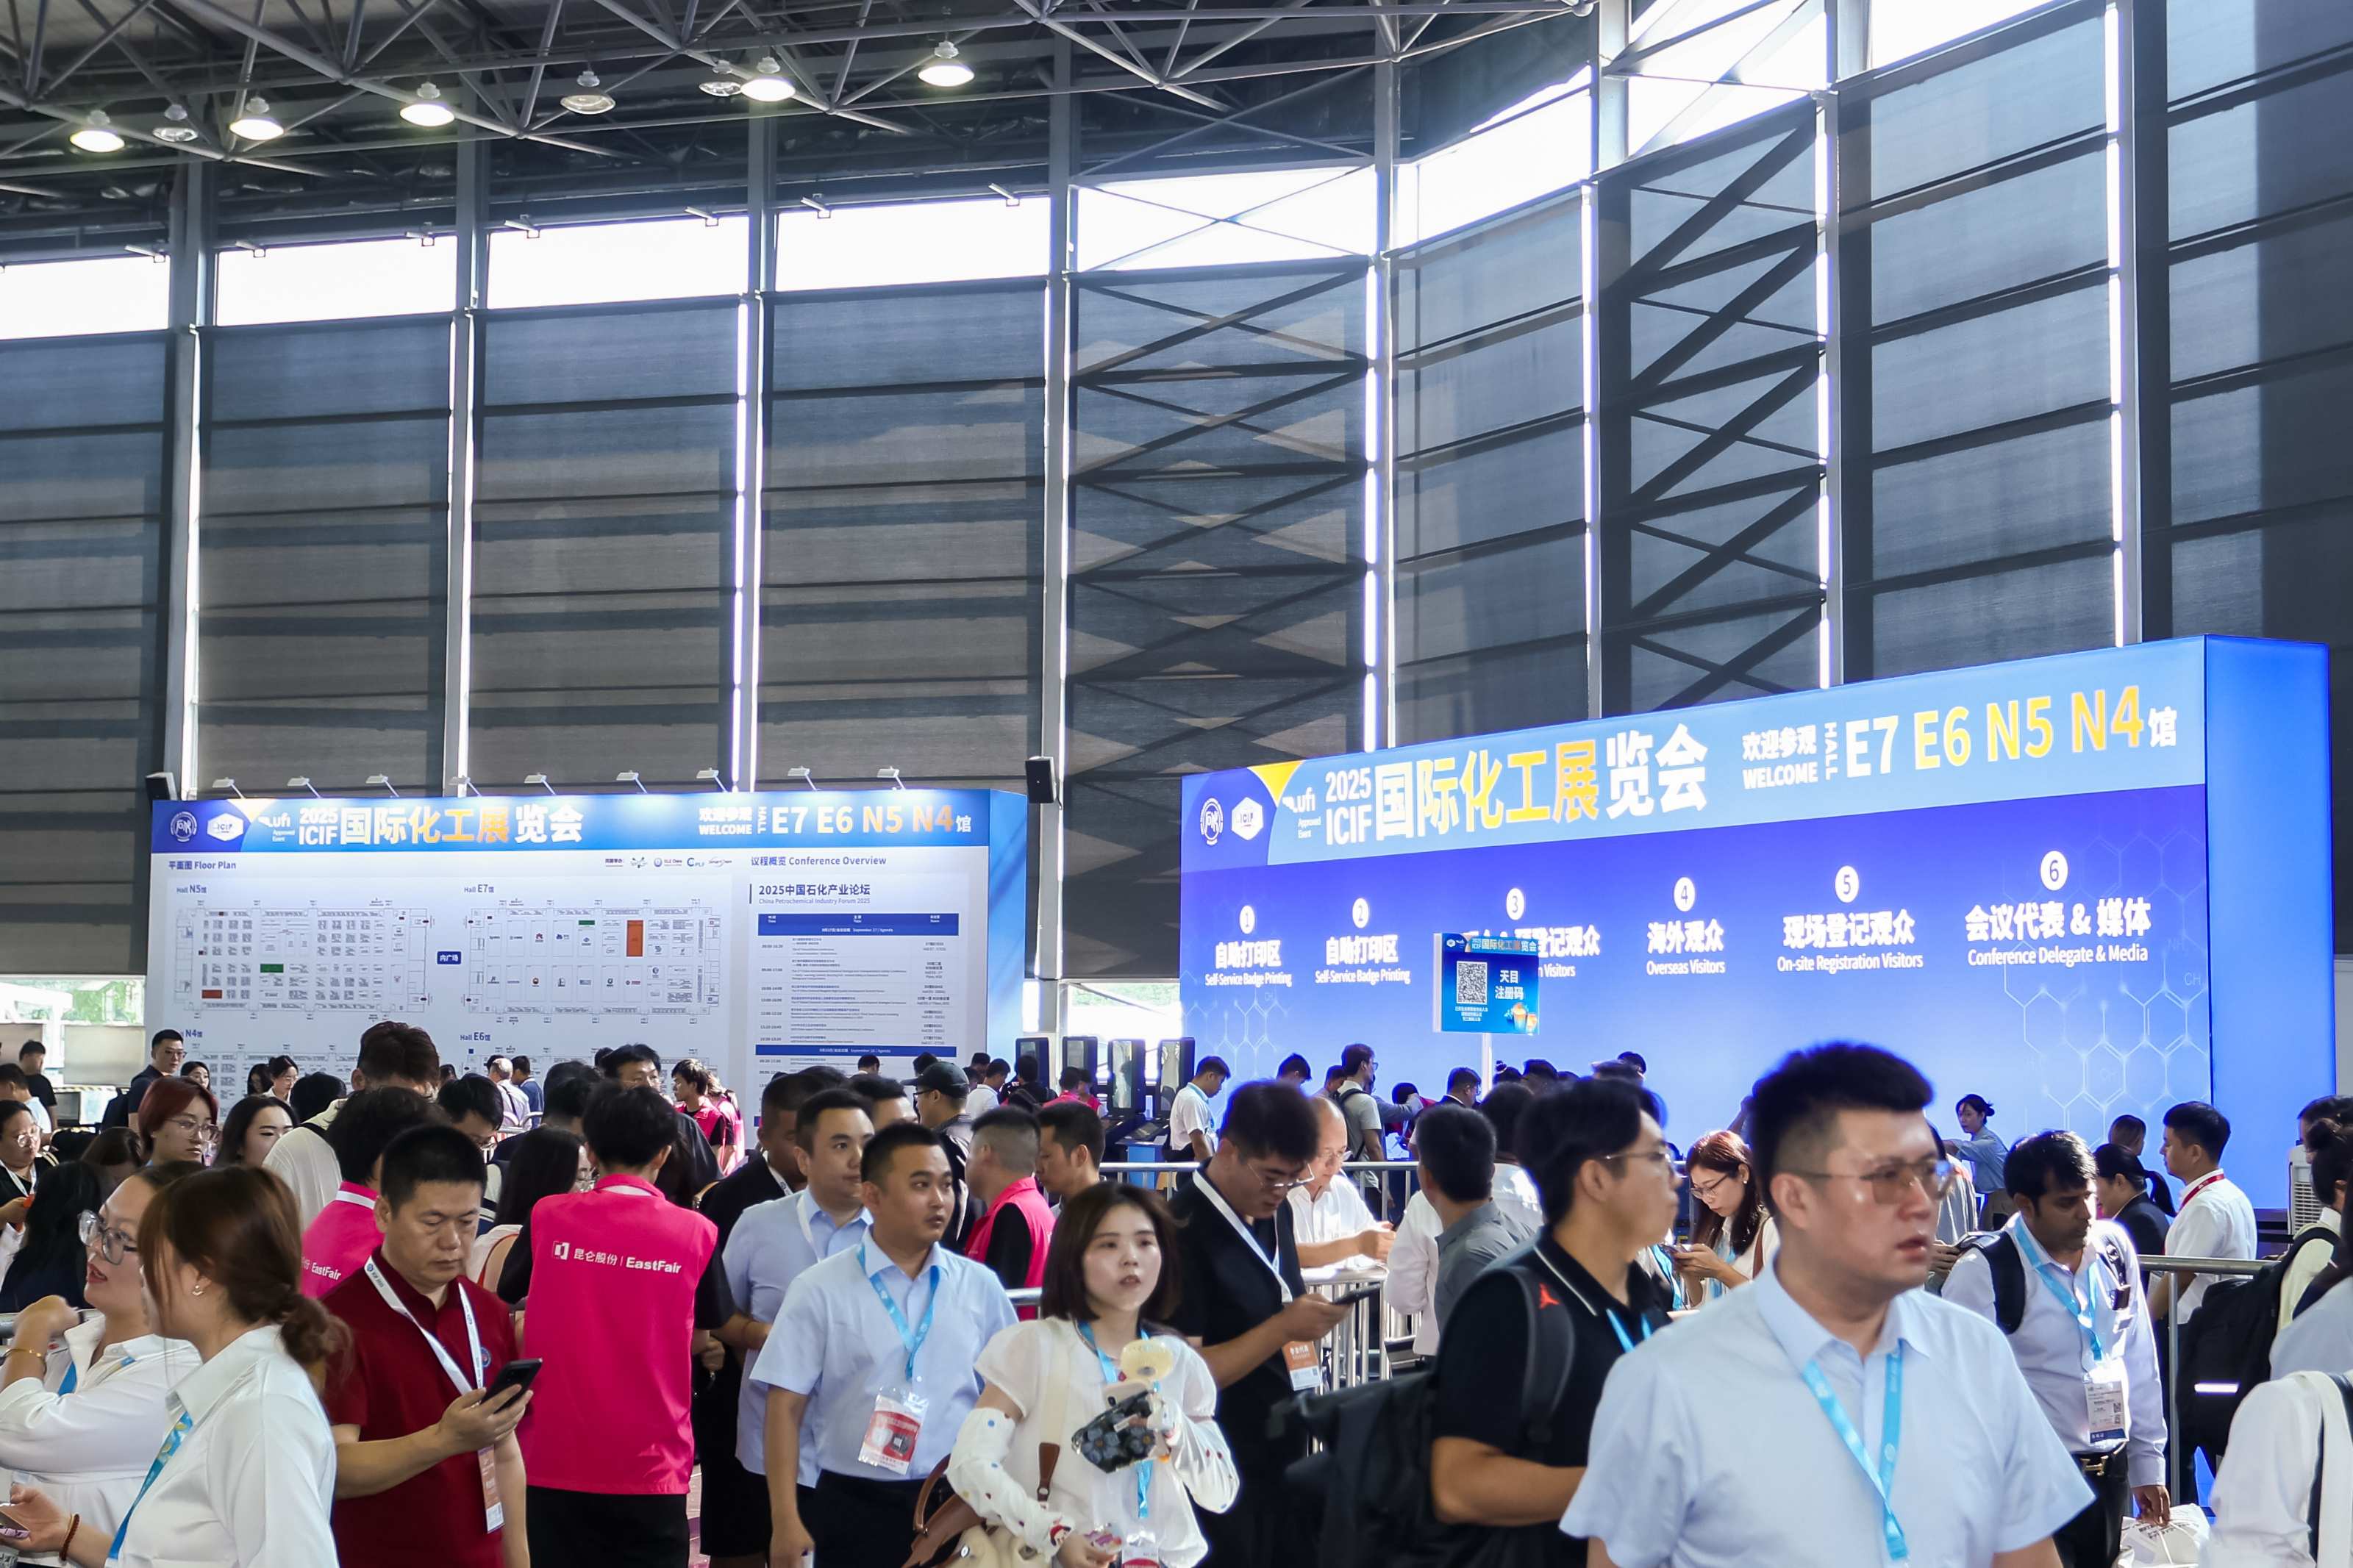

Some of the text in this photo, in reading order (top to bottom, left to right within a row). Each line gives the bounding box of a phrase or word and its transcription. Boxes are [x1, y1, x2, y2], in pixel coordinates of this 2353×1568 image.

[1743, 725, 1816, 761] 欢迎参观
[1846, 715, 1899, 778] E7
[1914, 706, 1971, 770] E6
[1987, 695, 2054, 762] N5
[1824, 722, 1838, 780] HALL
[1326, 767, 1371, 802] 2025
[1375, 723, 1708, 840] 国际化工展览会
[1743, 762, 1818, 789] WELCOME
[299, 807, 339, 823] 2025
[340, 804, 584, 845] 国际化工展览会
[758, 806, 767, 834] HALL
[773, 807, 809, 834] E7
[818, 806, 853, 834] E6
[863, 806, 902, 833] N5
[1326, 804, 1372, 845] ICIF
[299, 826, 338, 845] ICIF
[699, 824, 751, 834] WELCOME
[168, 860, 236, 870] 平面图 Floor Plan
[751, 856, 886, 866] 议程概览 Conference Overview
[759, 884, 871, 895] 2025中国石化产业论坛
[1782, 909, 1915, 949] 现场登记观众
[1965, 897, 2152, 942] 会议代表 & 媒体
[1647, 919, 1724, 954] 海外观众
[1215, 940, 1282, 969] 自助打印区
[1326, 934, 1399, 965] 自助打印区
[1968, 943, 2149, 968] Conference Delegate & Media
[1543, 964, 1576, 977] Visitors
[1646, 959, 1726, 975] Overseas Visitors
[1777, 952, 1924, 975] On-site Registration Visitors
[1205, 971, 1292, 988] Self-Service Badge Printing
[1315, 968, 1410, 985] Self-Service Badge Printing
[1500, 970, 1518, 984] 天目
[1495, 987, 1524, 1000] 注册码
[311, 1261, 342, 1281] EastFair
[574, 1248, 682, 1273] 昆仑股份 EastFair
